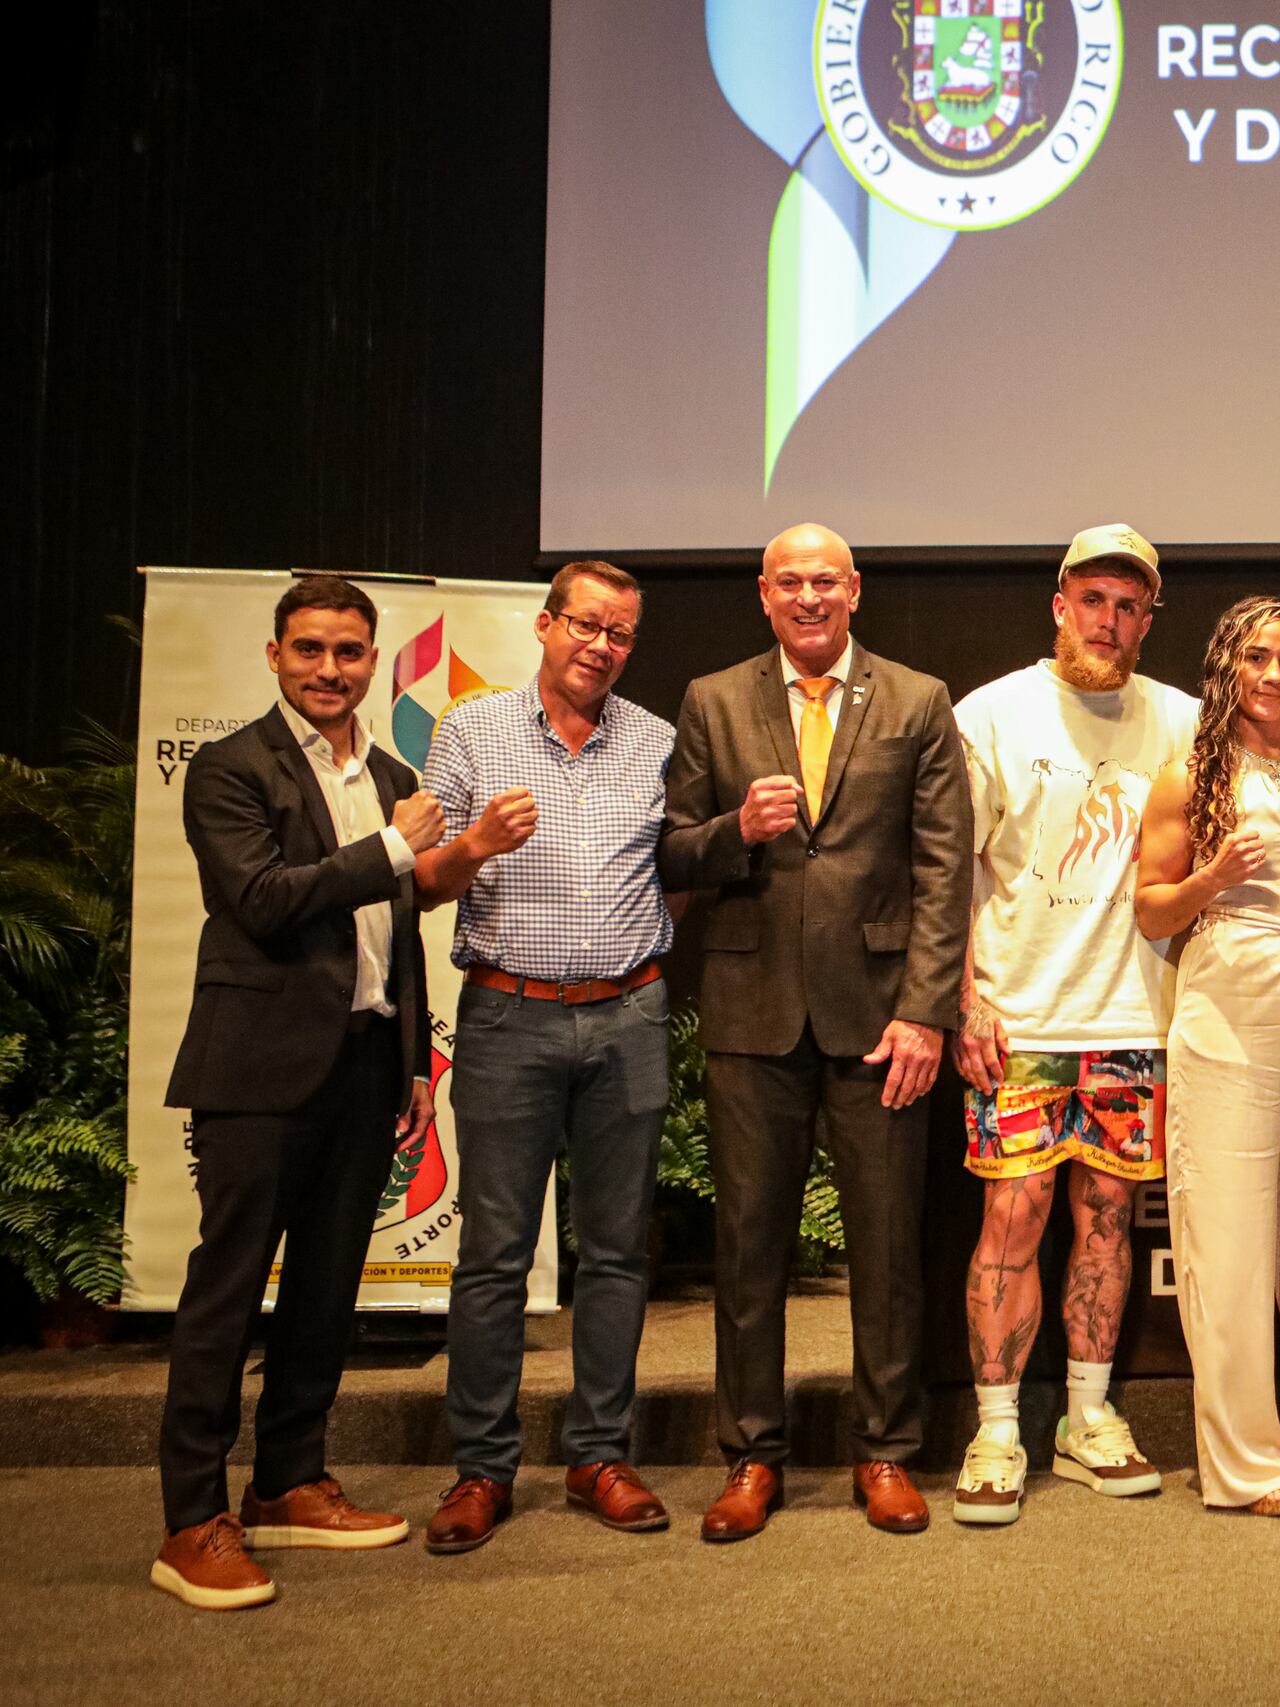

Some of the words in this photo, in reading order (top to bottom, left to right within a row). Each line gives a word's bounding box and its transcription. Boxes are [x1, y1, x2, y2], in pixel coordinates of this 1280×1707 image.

[1051, 42, 1111, 164] RICO
[1173, 108, 1216, 162] Y
[157, 763, 178, 786] Y
[390, 1268, 397, 1276] Y
[399, 1267, 450, 1276] DEPORTES
